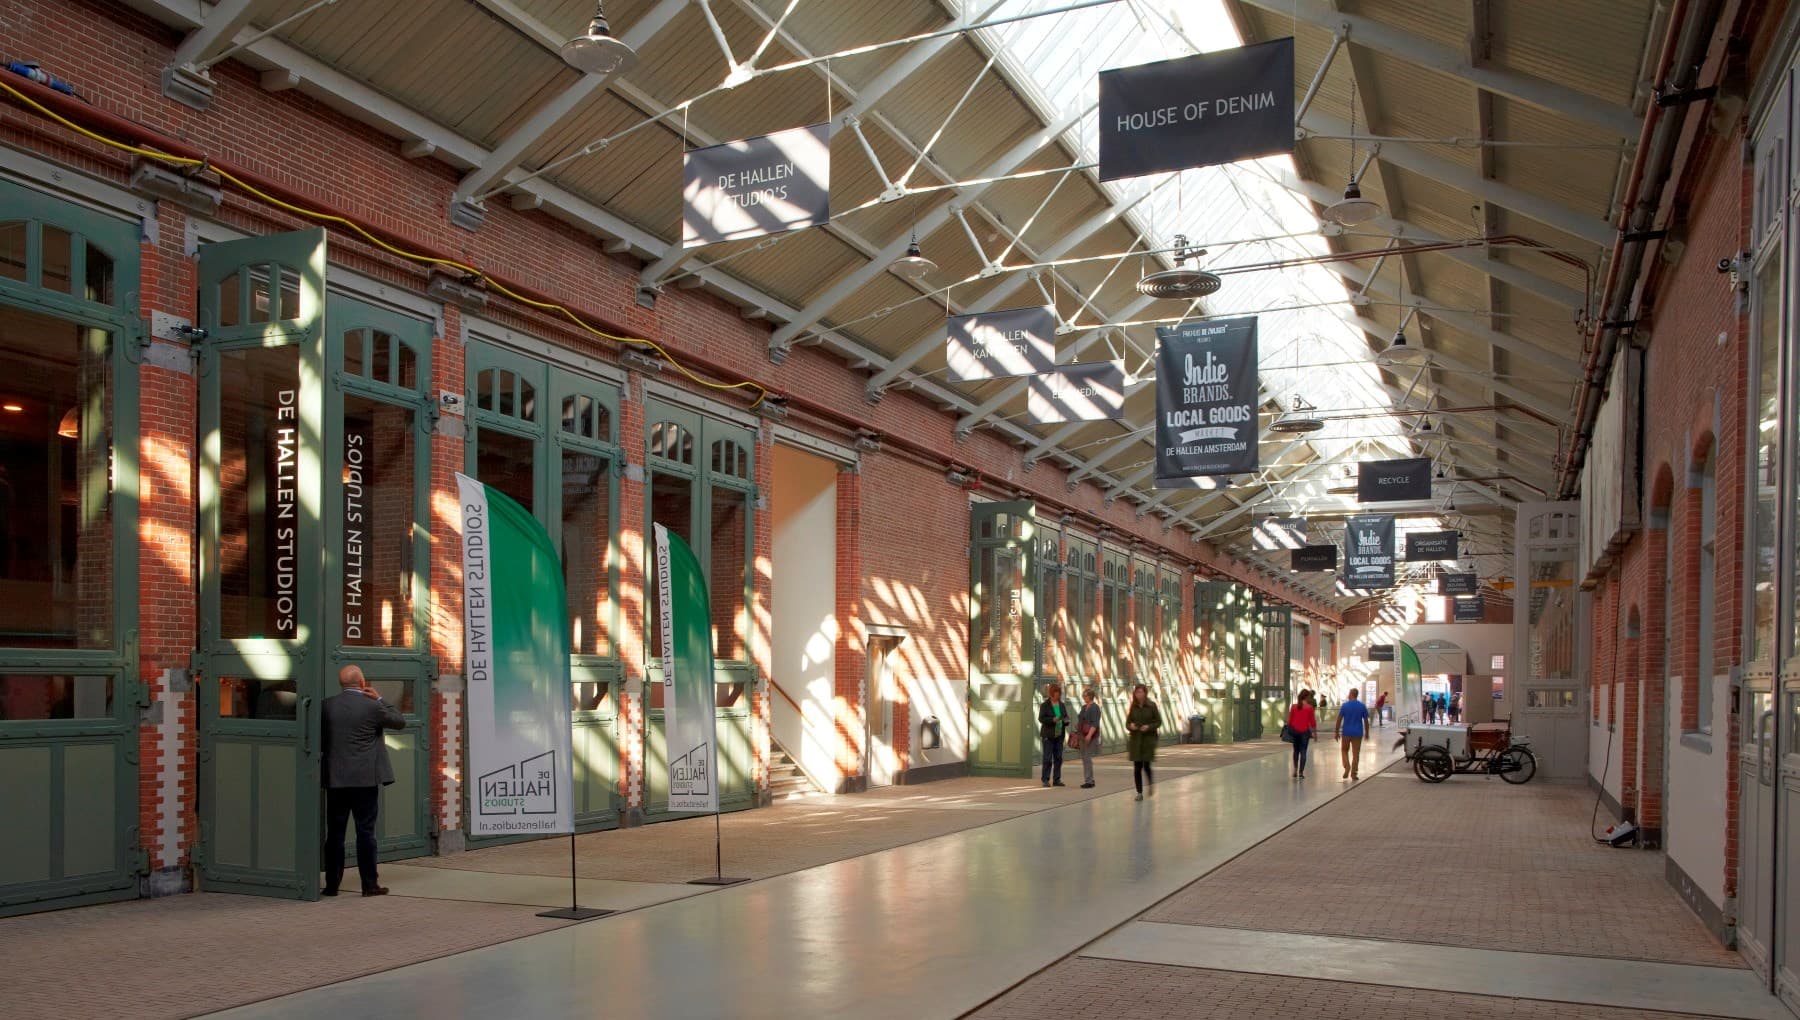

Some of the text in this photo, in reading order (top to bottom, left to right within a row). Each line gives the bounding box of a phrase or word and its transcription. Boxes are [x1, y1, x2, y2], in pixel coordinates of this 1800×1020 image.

[1117, 91, 1275, 132] HOUSE OF DENIM
[718, 162, 794, 191] DE HALLEN
[727, 185, 788, 209] TUDIO'S
[973, 345, 1028, 359] KANEN
[1183, 351, 1229, 386] Indie
[1166, 405, 1251, 428] LOCAL GOODS
[1166, 442, 1247, 456] DE HALLEN AMSTERDAM
[1378, 476, 1410, 485] RECYCLE
[277, 390, 295, 631] DE HALLEN STUDIO'S
[346, 434, 363, 639] DE HALLEN STUDIO'S
[1357, 529, 1381, 546] Indie
[1349, 556, 1391, 565] LOCAL GOODS
